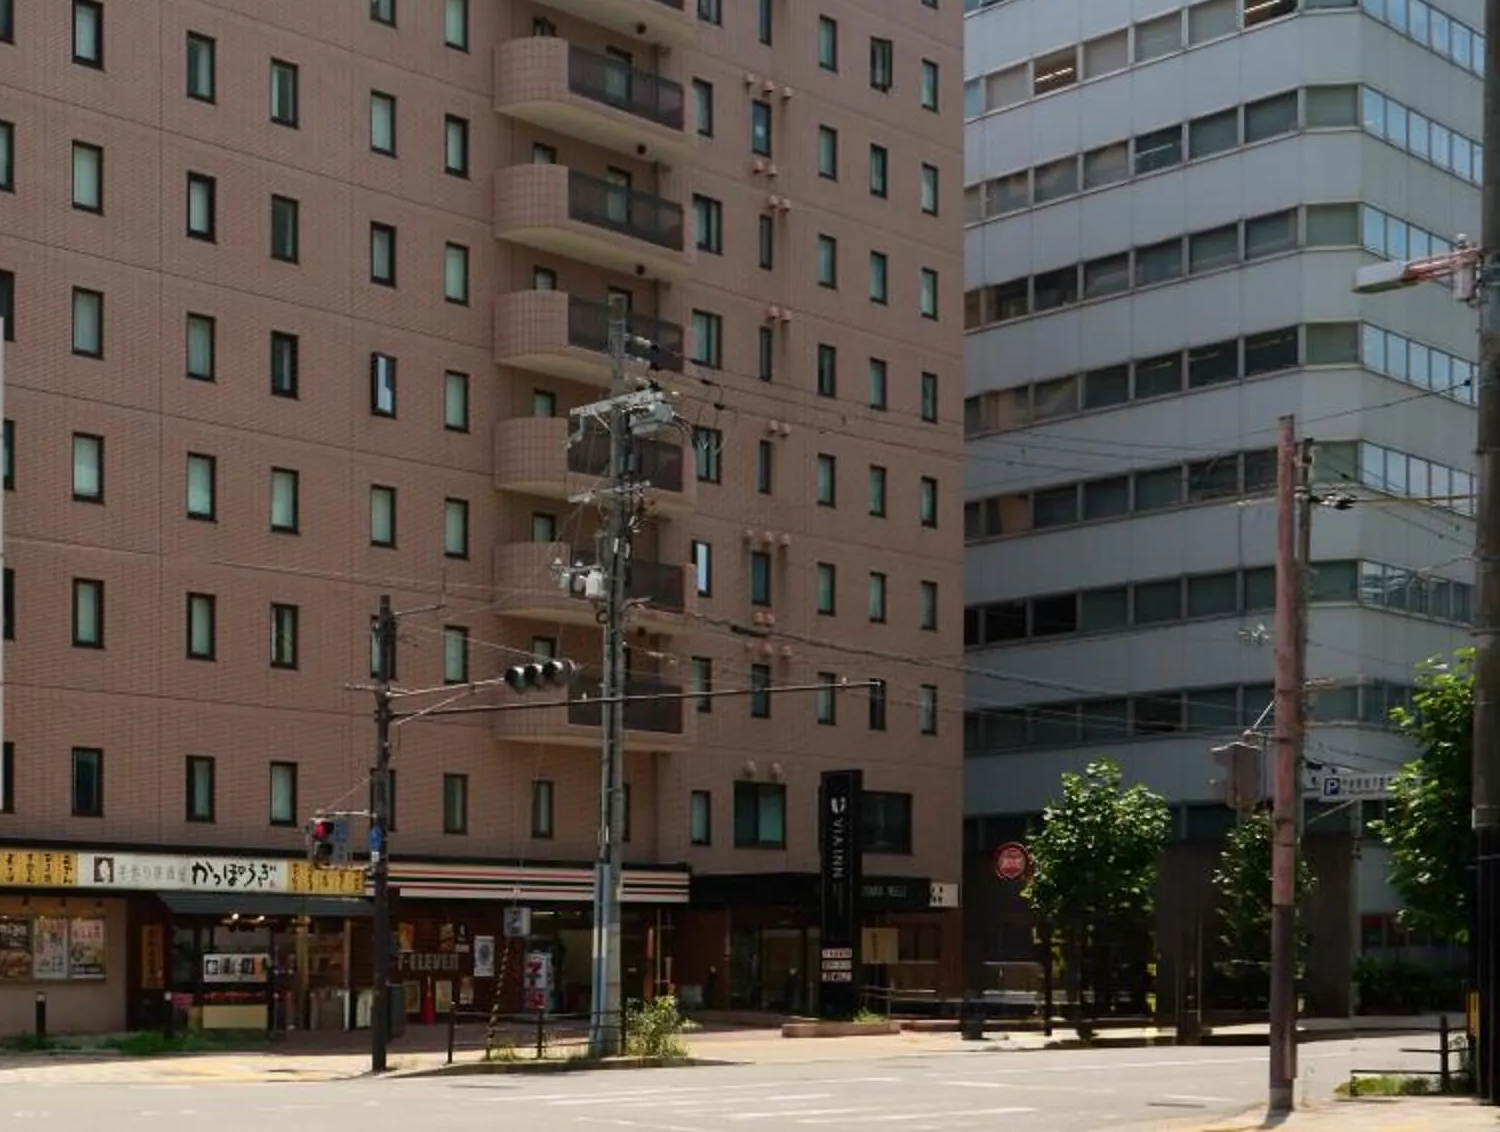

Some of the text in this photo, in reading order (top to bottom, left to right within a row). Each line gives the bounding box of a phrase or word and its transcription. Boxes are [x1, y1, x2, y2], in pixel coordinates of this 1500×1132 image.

[191, 860, 277, 888] かっぽうぎ
